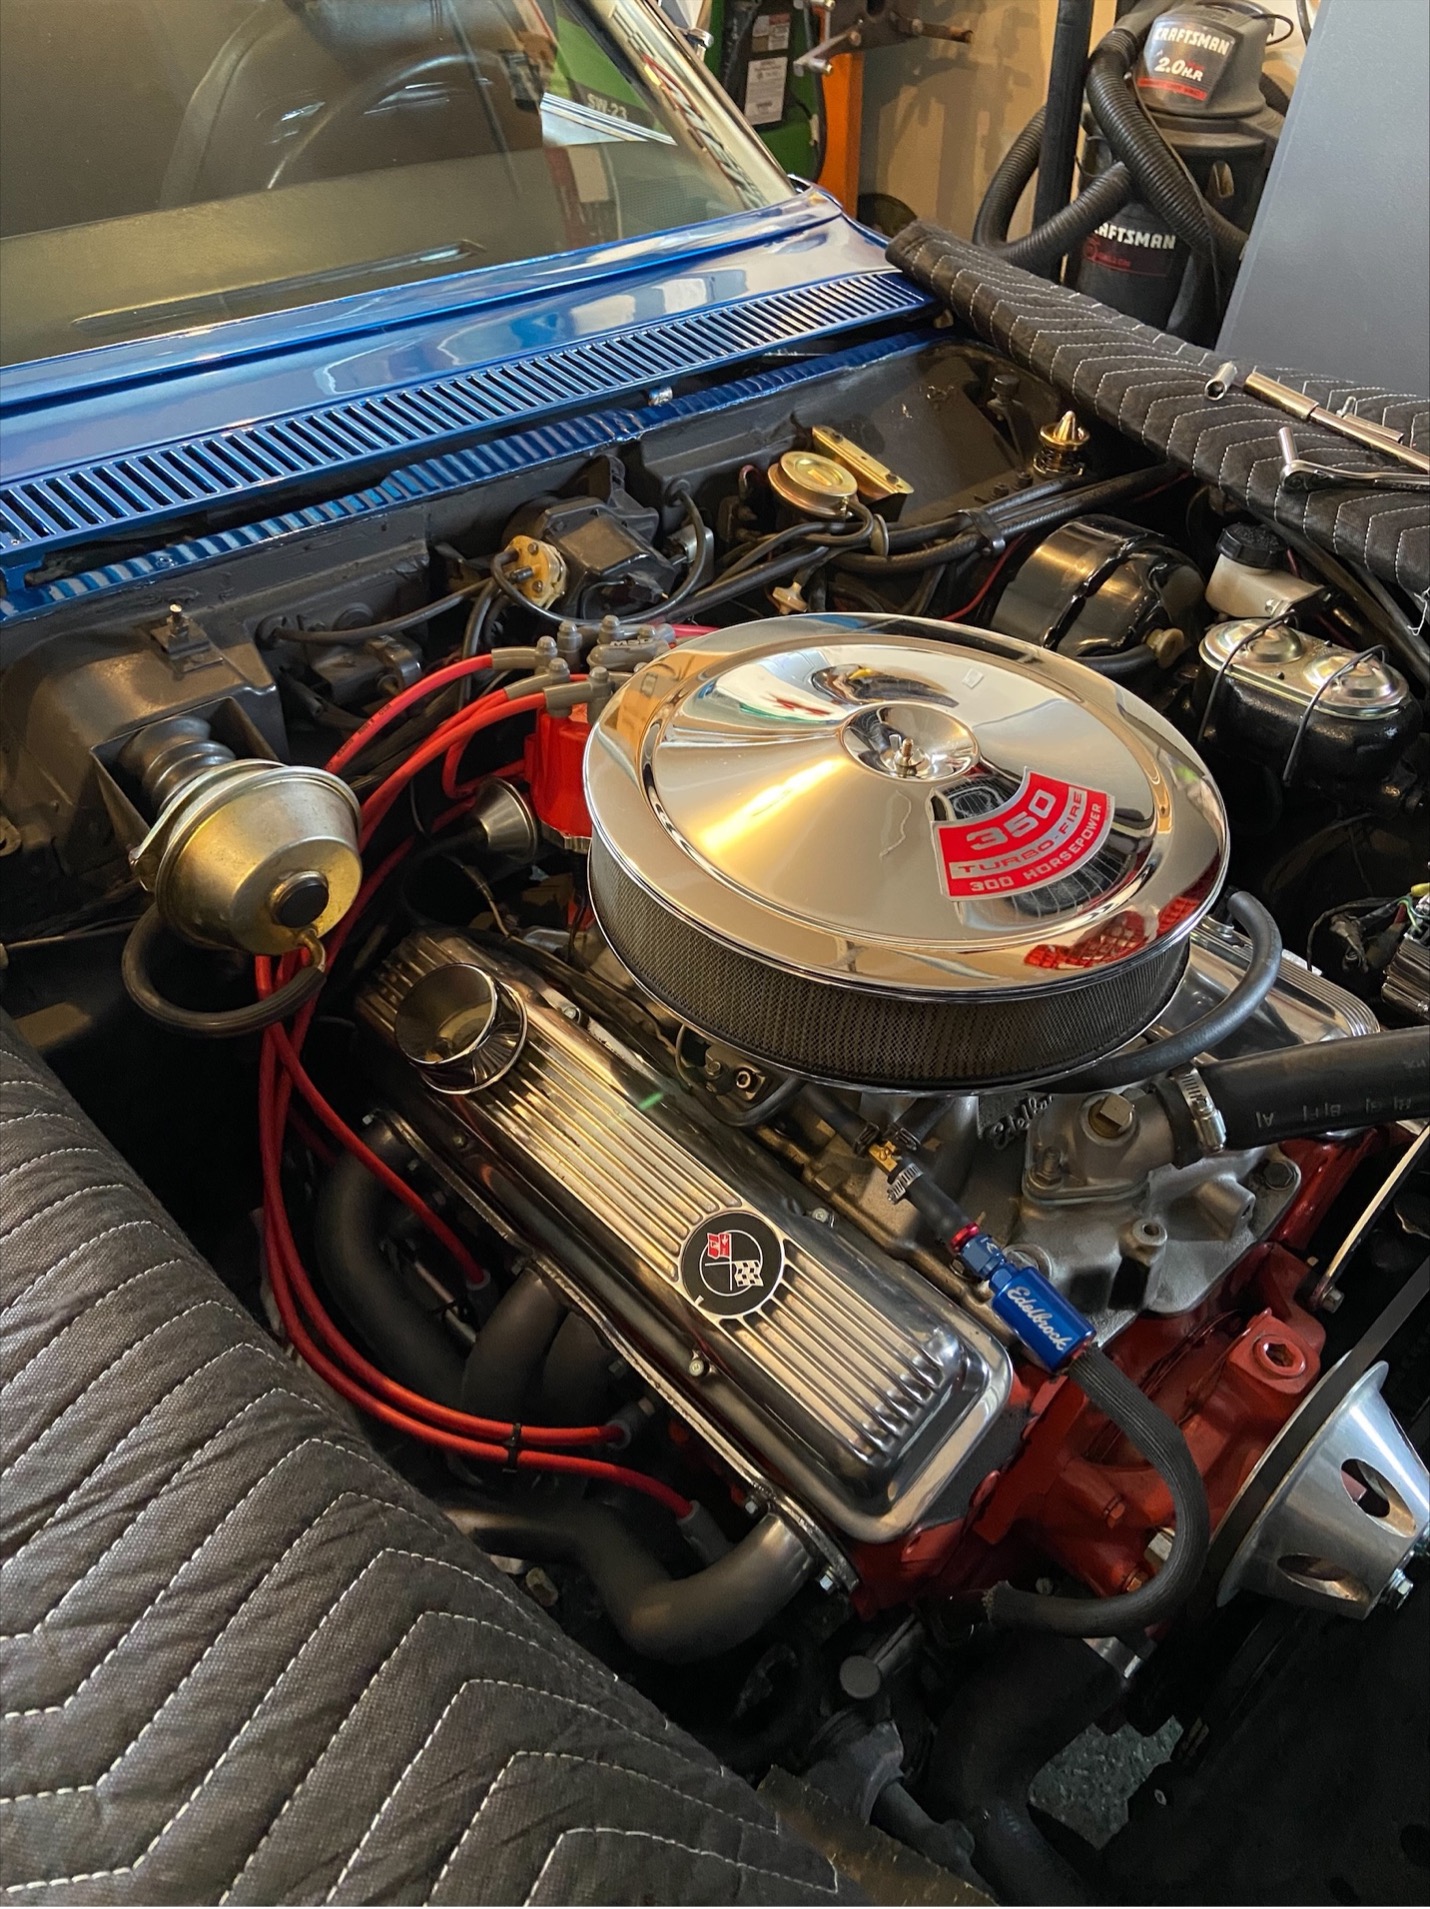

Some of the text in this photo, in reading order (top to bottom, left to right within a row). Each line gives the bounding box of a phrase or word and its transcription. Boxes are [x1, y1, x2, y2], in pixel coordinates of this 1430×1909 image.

[1153, 27, 1230, 55] CRAFTSMAN
[1094, 222, 1176, 249] AFTSMAN
[958, 790, 1082, 873] TURBO-FIRE
[966, 789, 1056, 850] 350
[969, 876, 1014, 892] 300
[1023, 803, 1102, 881] HORSEPOWER
[1007, 1286, 1072, 1351] Edelbrock
